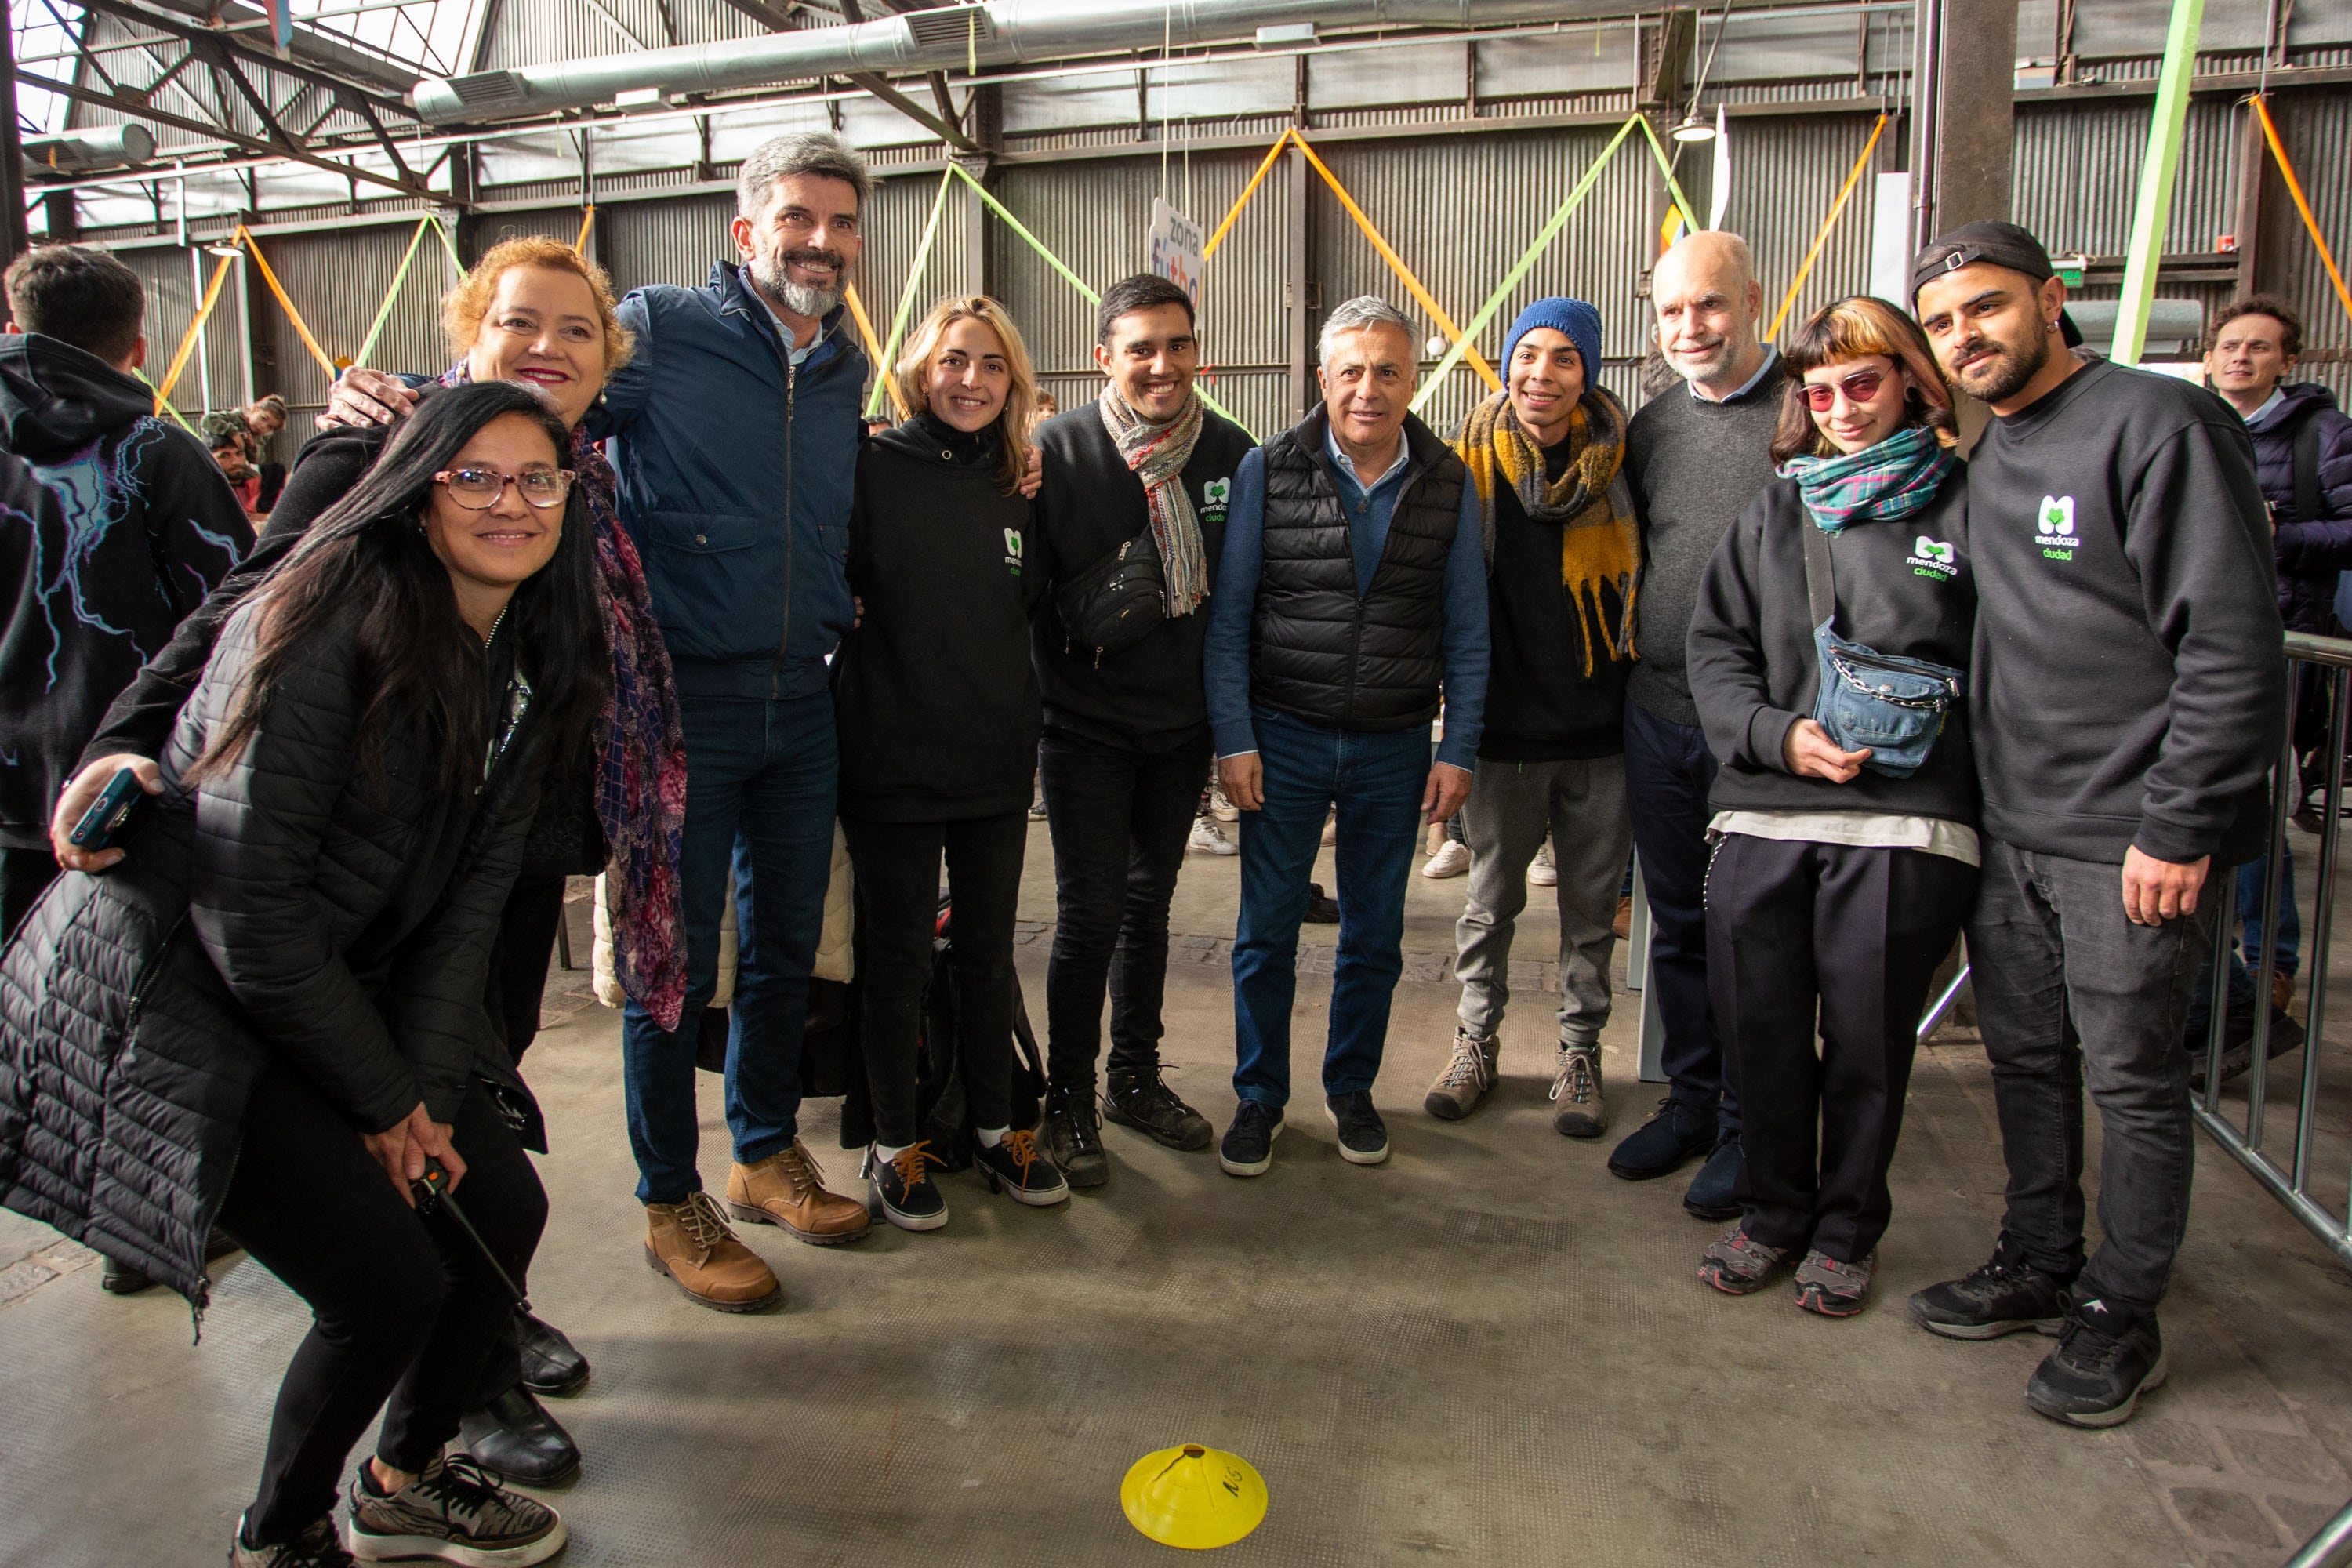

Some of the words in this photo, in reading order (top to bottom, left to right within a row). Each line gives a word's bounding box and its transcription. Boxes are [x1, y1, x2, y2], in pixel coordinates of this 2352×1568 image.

[1170, 216, 1199, 257] zona
[1200, 503, 1227, 514] mendo
[1205, 513, 1225, 521] ciuda
[2034, 534, 2079, 547] mendoza
[2042, 547, 2072, 561] ciudad
[1906, 557, 1958, 575] mendoza
[1913, 567, 1948, 583] ciudad
